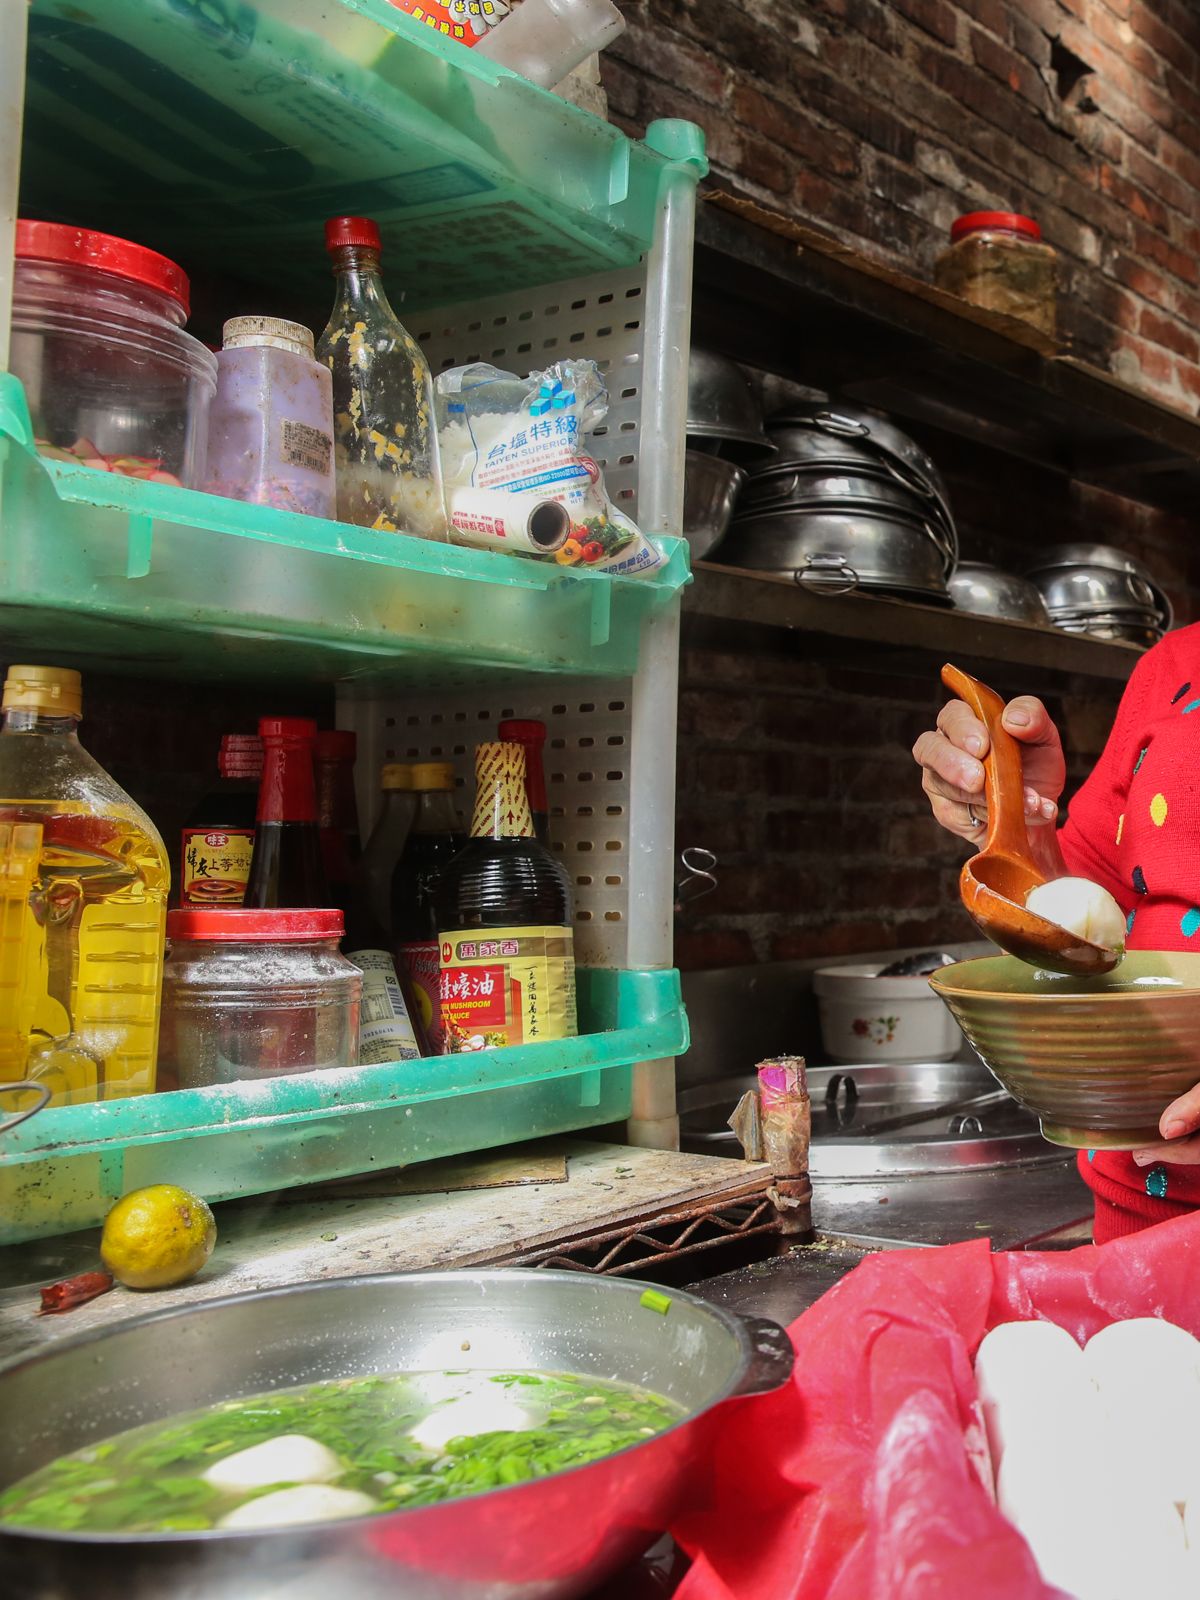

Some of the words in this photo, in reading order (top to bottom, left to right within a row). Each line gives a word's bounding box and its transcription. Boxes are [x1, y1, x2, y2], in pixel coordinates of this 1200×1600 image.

[485, 453, 518, 469] TAIYEN
[207, 834, 226, 846] 味王
[460, 940, 519, 958] 萬家香
[415, 961, 440, 975] SAUC
[450, 1000, 491, 1010] MUSHROOM
[450, 1012, 470, 1020] SAUCE
